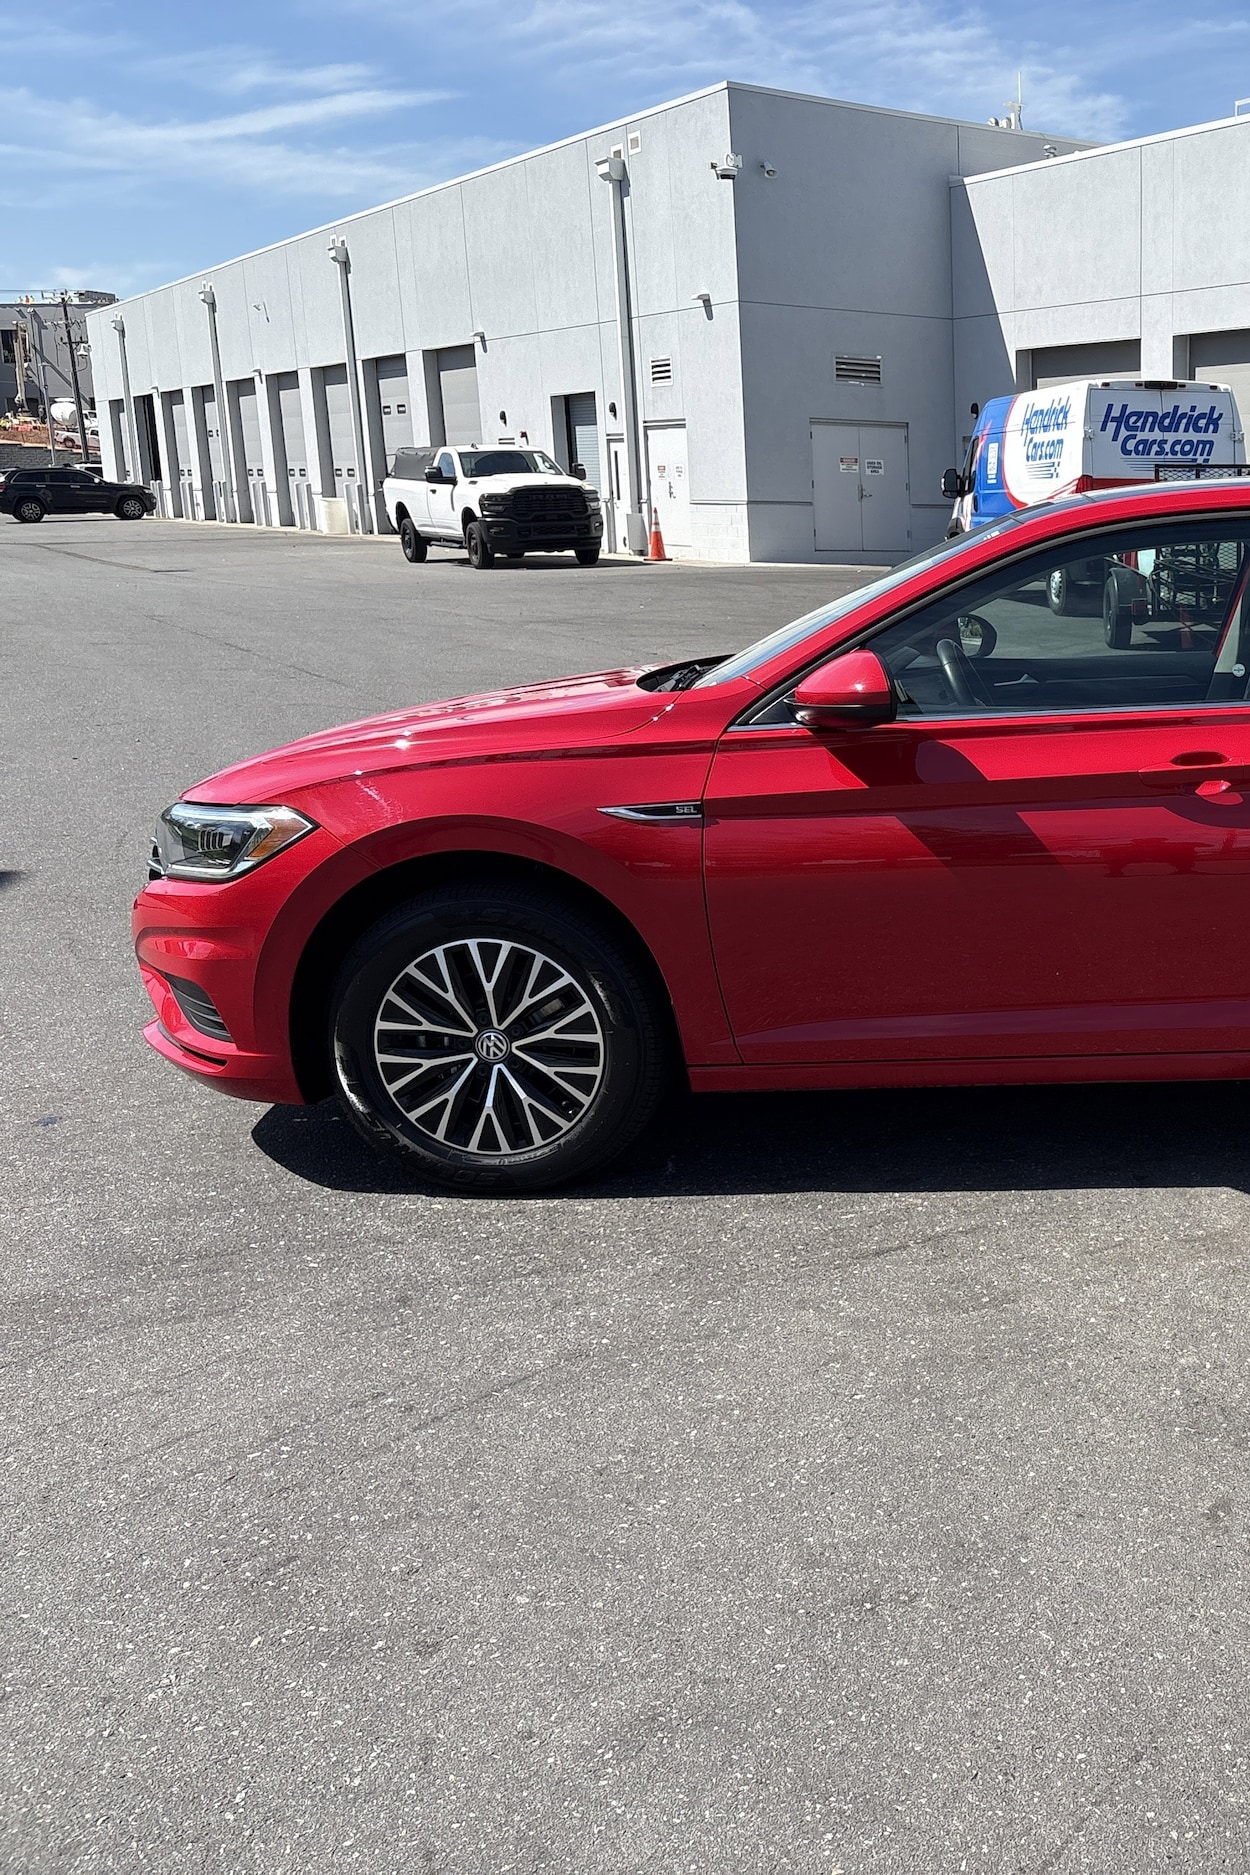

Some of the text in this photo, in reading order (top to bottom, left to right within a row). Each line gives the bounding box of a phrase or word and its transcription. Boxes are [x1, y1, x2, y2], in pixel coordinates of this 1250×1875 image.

[1021, 395, 1072, 447] Hendrick
[1100, 403, 1224, 442] Hendrick
[1026, 436, 1064, 462] Cars.com
[1120, 433, 1215, 457] Cars.com
[675, 805, 698, 814] SEL
